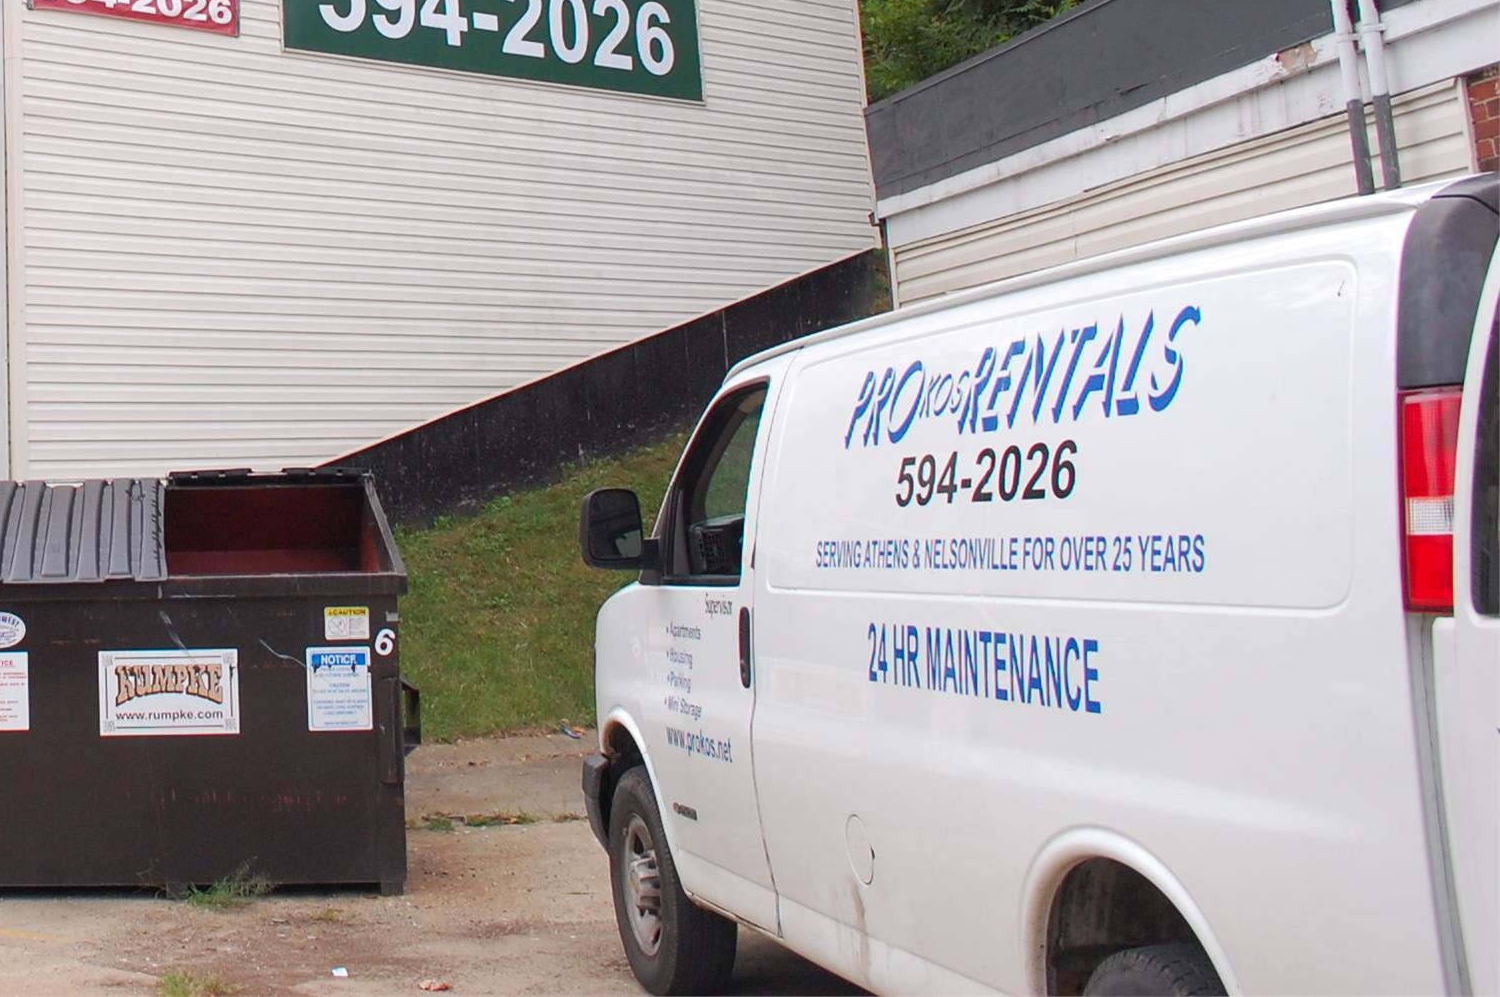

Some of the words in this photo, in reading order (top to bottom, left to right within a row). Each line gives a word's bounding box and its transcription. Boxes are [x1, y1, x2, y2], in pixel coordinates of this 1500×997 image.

[957, 305, 1201, 435] RENTALS
[895, 440, 1077, 507] 594-2026
[816, 539, 861, 568] SERVING
[863, 539, 909, 569] ATHENS
[912, 539, 922, 569] &
[924, 537, 1018, 570] NELSONVILLE
[1023, 537, 1055, 571] FOR
[1060, 536, 1107, 572] OVER
[1112, 536, 1132, 572] 25
[1137, 534, 1205, 573] YEARS
[375, 628, 396, 656] 6
[669, 622, 701, 640] Apartments
[868, 622, 888, 683] 24
[894, 624, 920, 688] HR
[926, 626, 1101, 714] MAINTENANCE
[115, 709, 223, 722] www.rumpke.com
[666, 726, 732, 763] www.prokos.net
